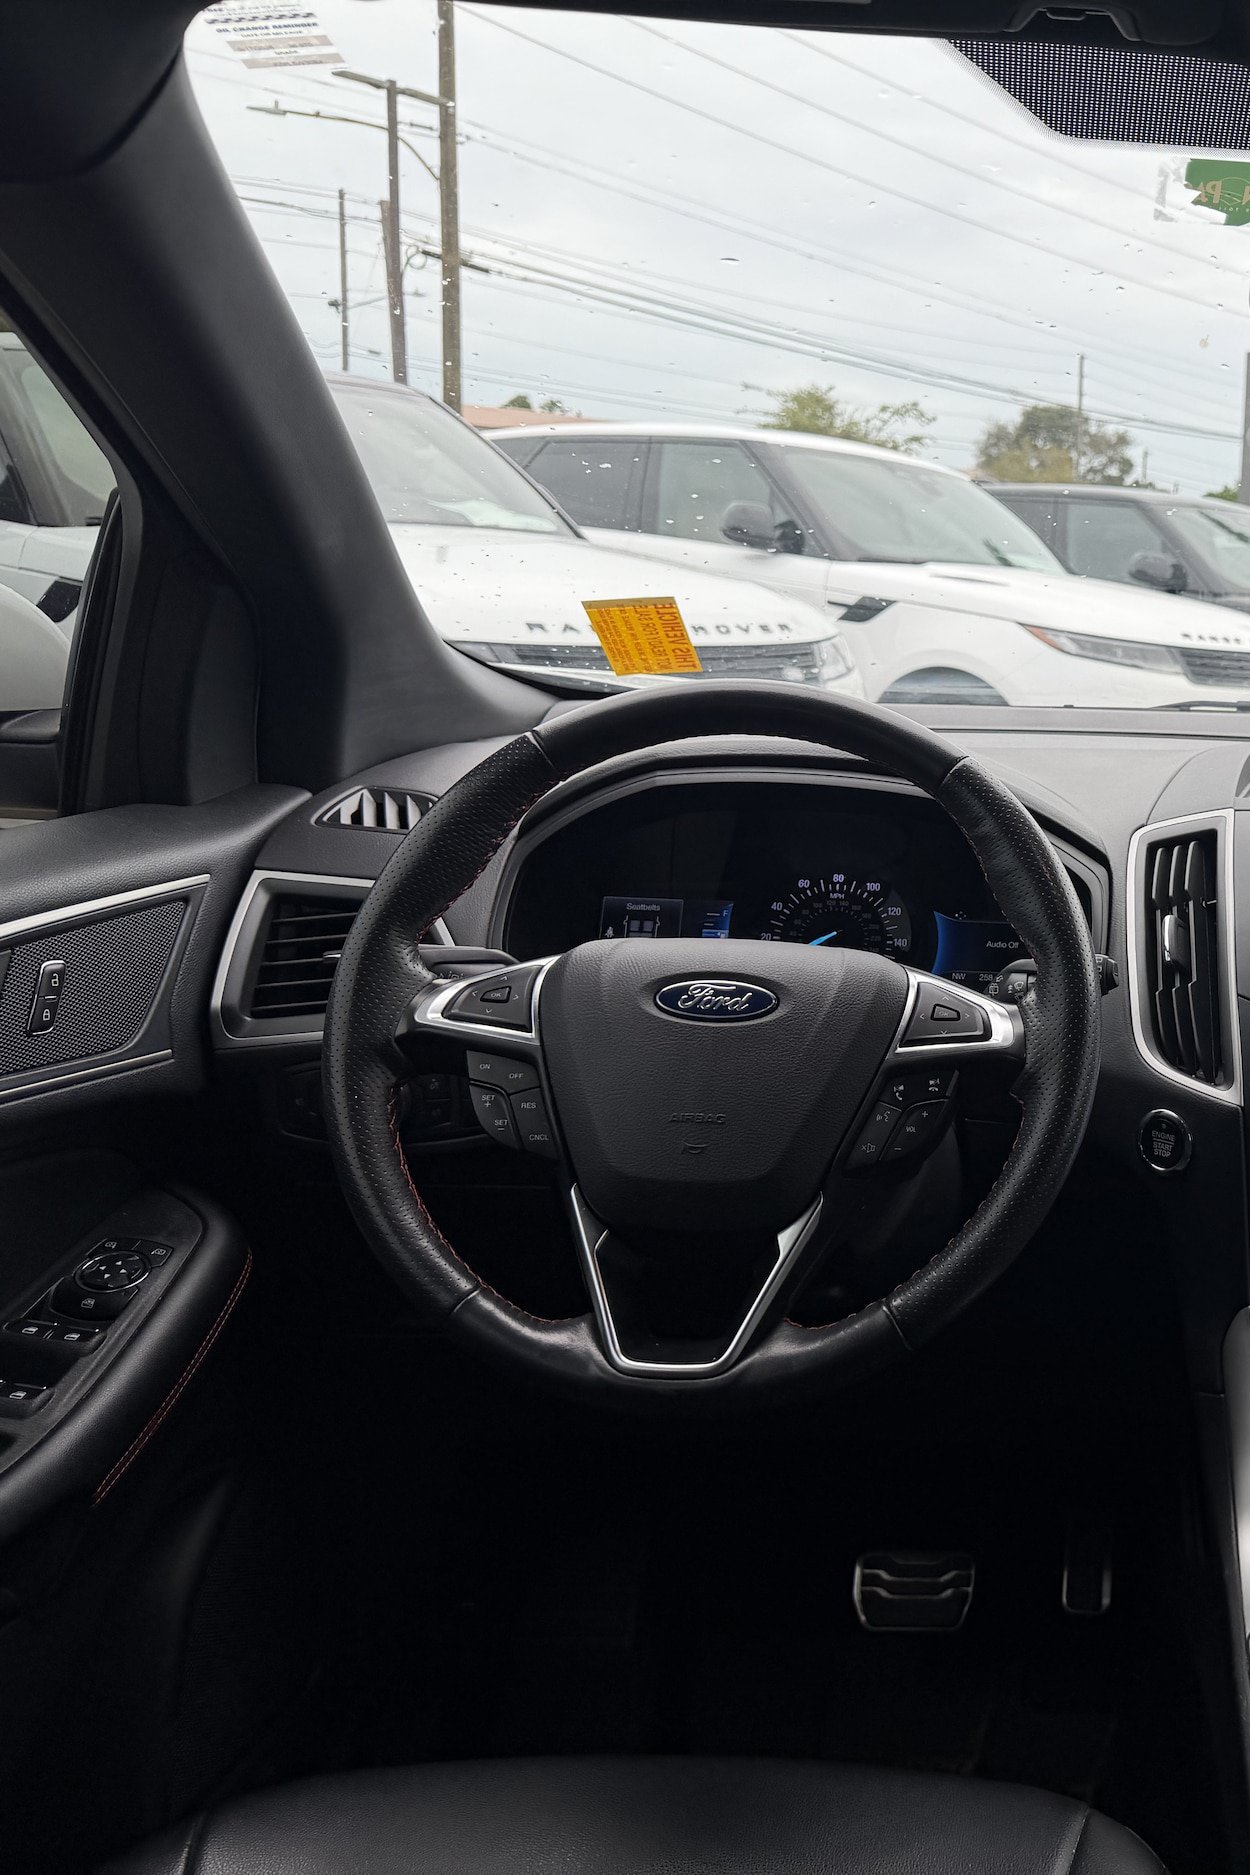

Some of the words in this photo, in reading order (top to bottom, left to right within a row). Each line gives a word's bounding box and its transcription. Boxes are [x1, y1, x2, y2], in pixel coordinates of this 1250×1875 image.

[272, 22, 318, 30] REMINDER
[832, 874, 844, 882] 80
[798, 879, 810, 888] 60
[866, 882, 881, 892] 100
[626, 902, 660, 912] Seatbelts
[771, 902, 783, 911] 40
[888, 907, 902, 916] 120
[760, 932, 772, 940] 20
[894, 938, 908, 947] 140
[986, 940, 1007, 948] Audio
[1008, 941, 1019, 949] Off
[678, 984, 752, 1012] Ford
[669, 1113, 726, 1123] AIRBAG
[1152, 1130, 1175, 1142] ENGINE
[1153, 1141, 1173, 1151] START
[1154, 1148, 1171, 1157] STOP
